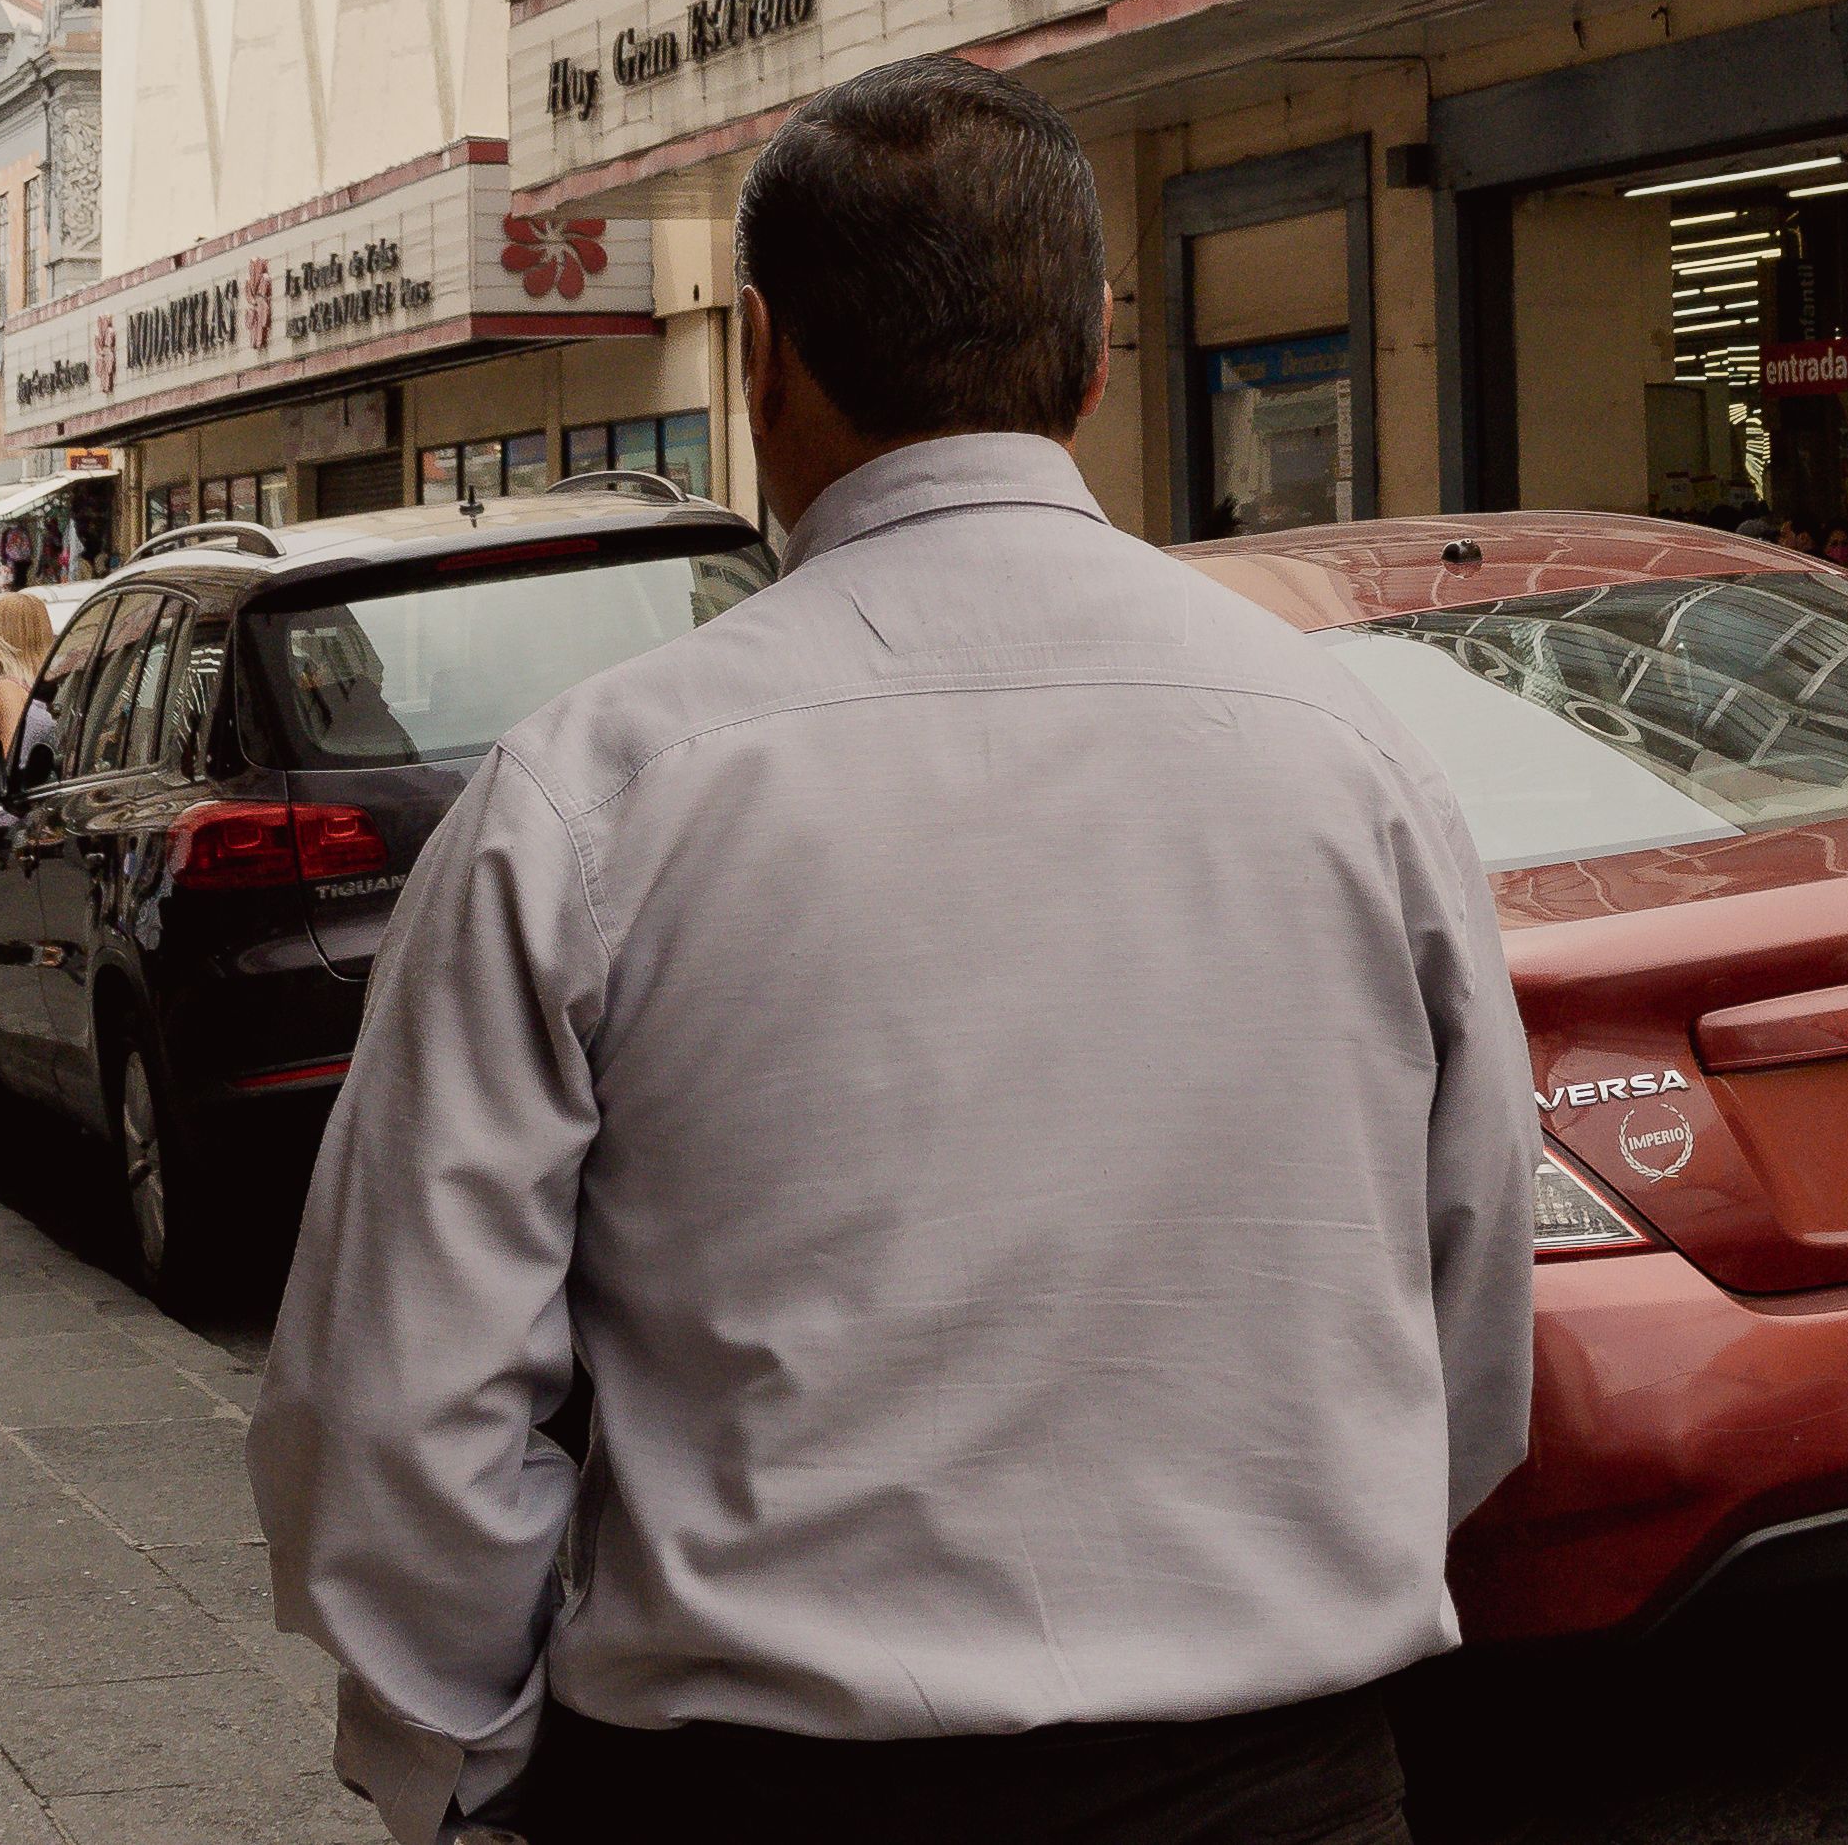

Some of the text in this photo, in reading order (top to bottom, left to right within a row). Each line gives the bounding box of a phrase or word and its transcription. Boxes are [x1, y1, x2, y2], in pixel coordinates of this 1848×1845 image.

[1766, 346, 1848, 385] entrada
[1534, 1069, 1690, 1111] VERSA
[1628, 1126, 1685, 1152] IMPERIO
